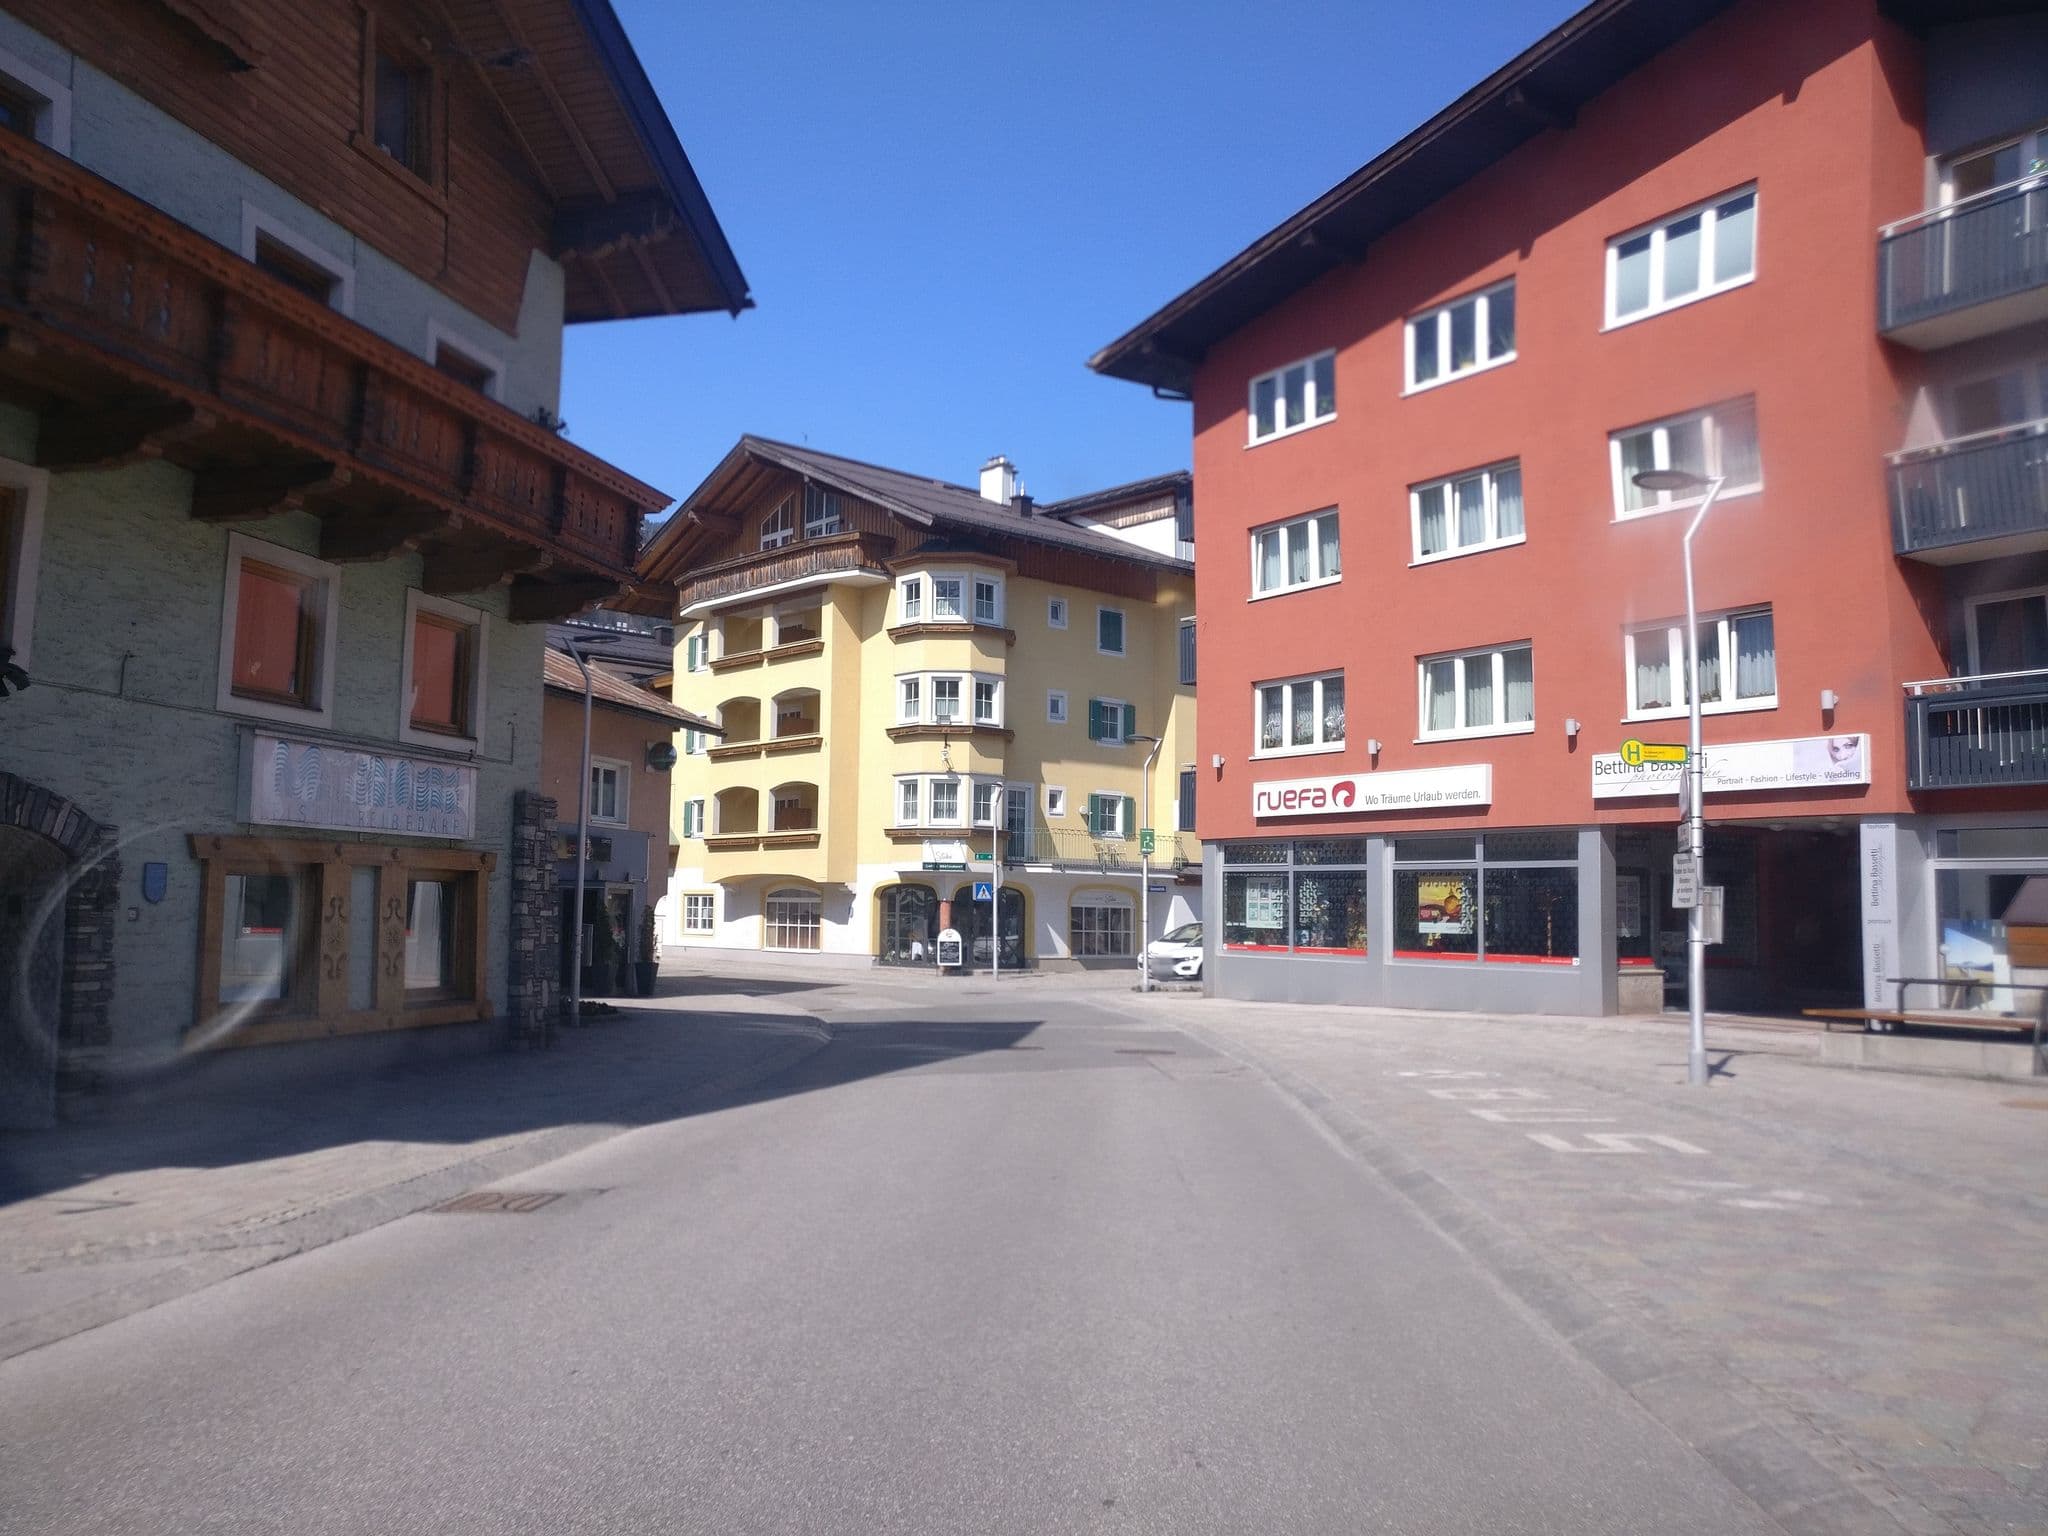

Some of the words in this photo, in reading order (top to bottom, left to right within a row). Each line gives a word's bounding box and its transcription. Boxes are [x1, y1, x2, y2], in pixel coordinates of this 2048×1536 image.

[1627, 744, 1641, 761] H
[1595, 760, 1645, 776] Bettina
[1650, 754, 1708, 771] Bassei
[1717, 776, 1744, 786] Portrait
[1750, 774, 1779, 784] Fashion
[1785, 771, 1817, 783] Lifestyle
[1824, 769, 1861, 781] Wedding
[1257, 787, 1327, 812] ruefa
[1365, 795, 1380, 806] Wo
[1381, 793, 1412, 805] Träume
[1413, 791, 1443, 803] Urlaub
[1444, 789, 1482, 801] werden.
[1870, 848, 1879, 878] Bassetti
[1871, 880, 1879, 907] Bettina
